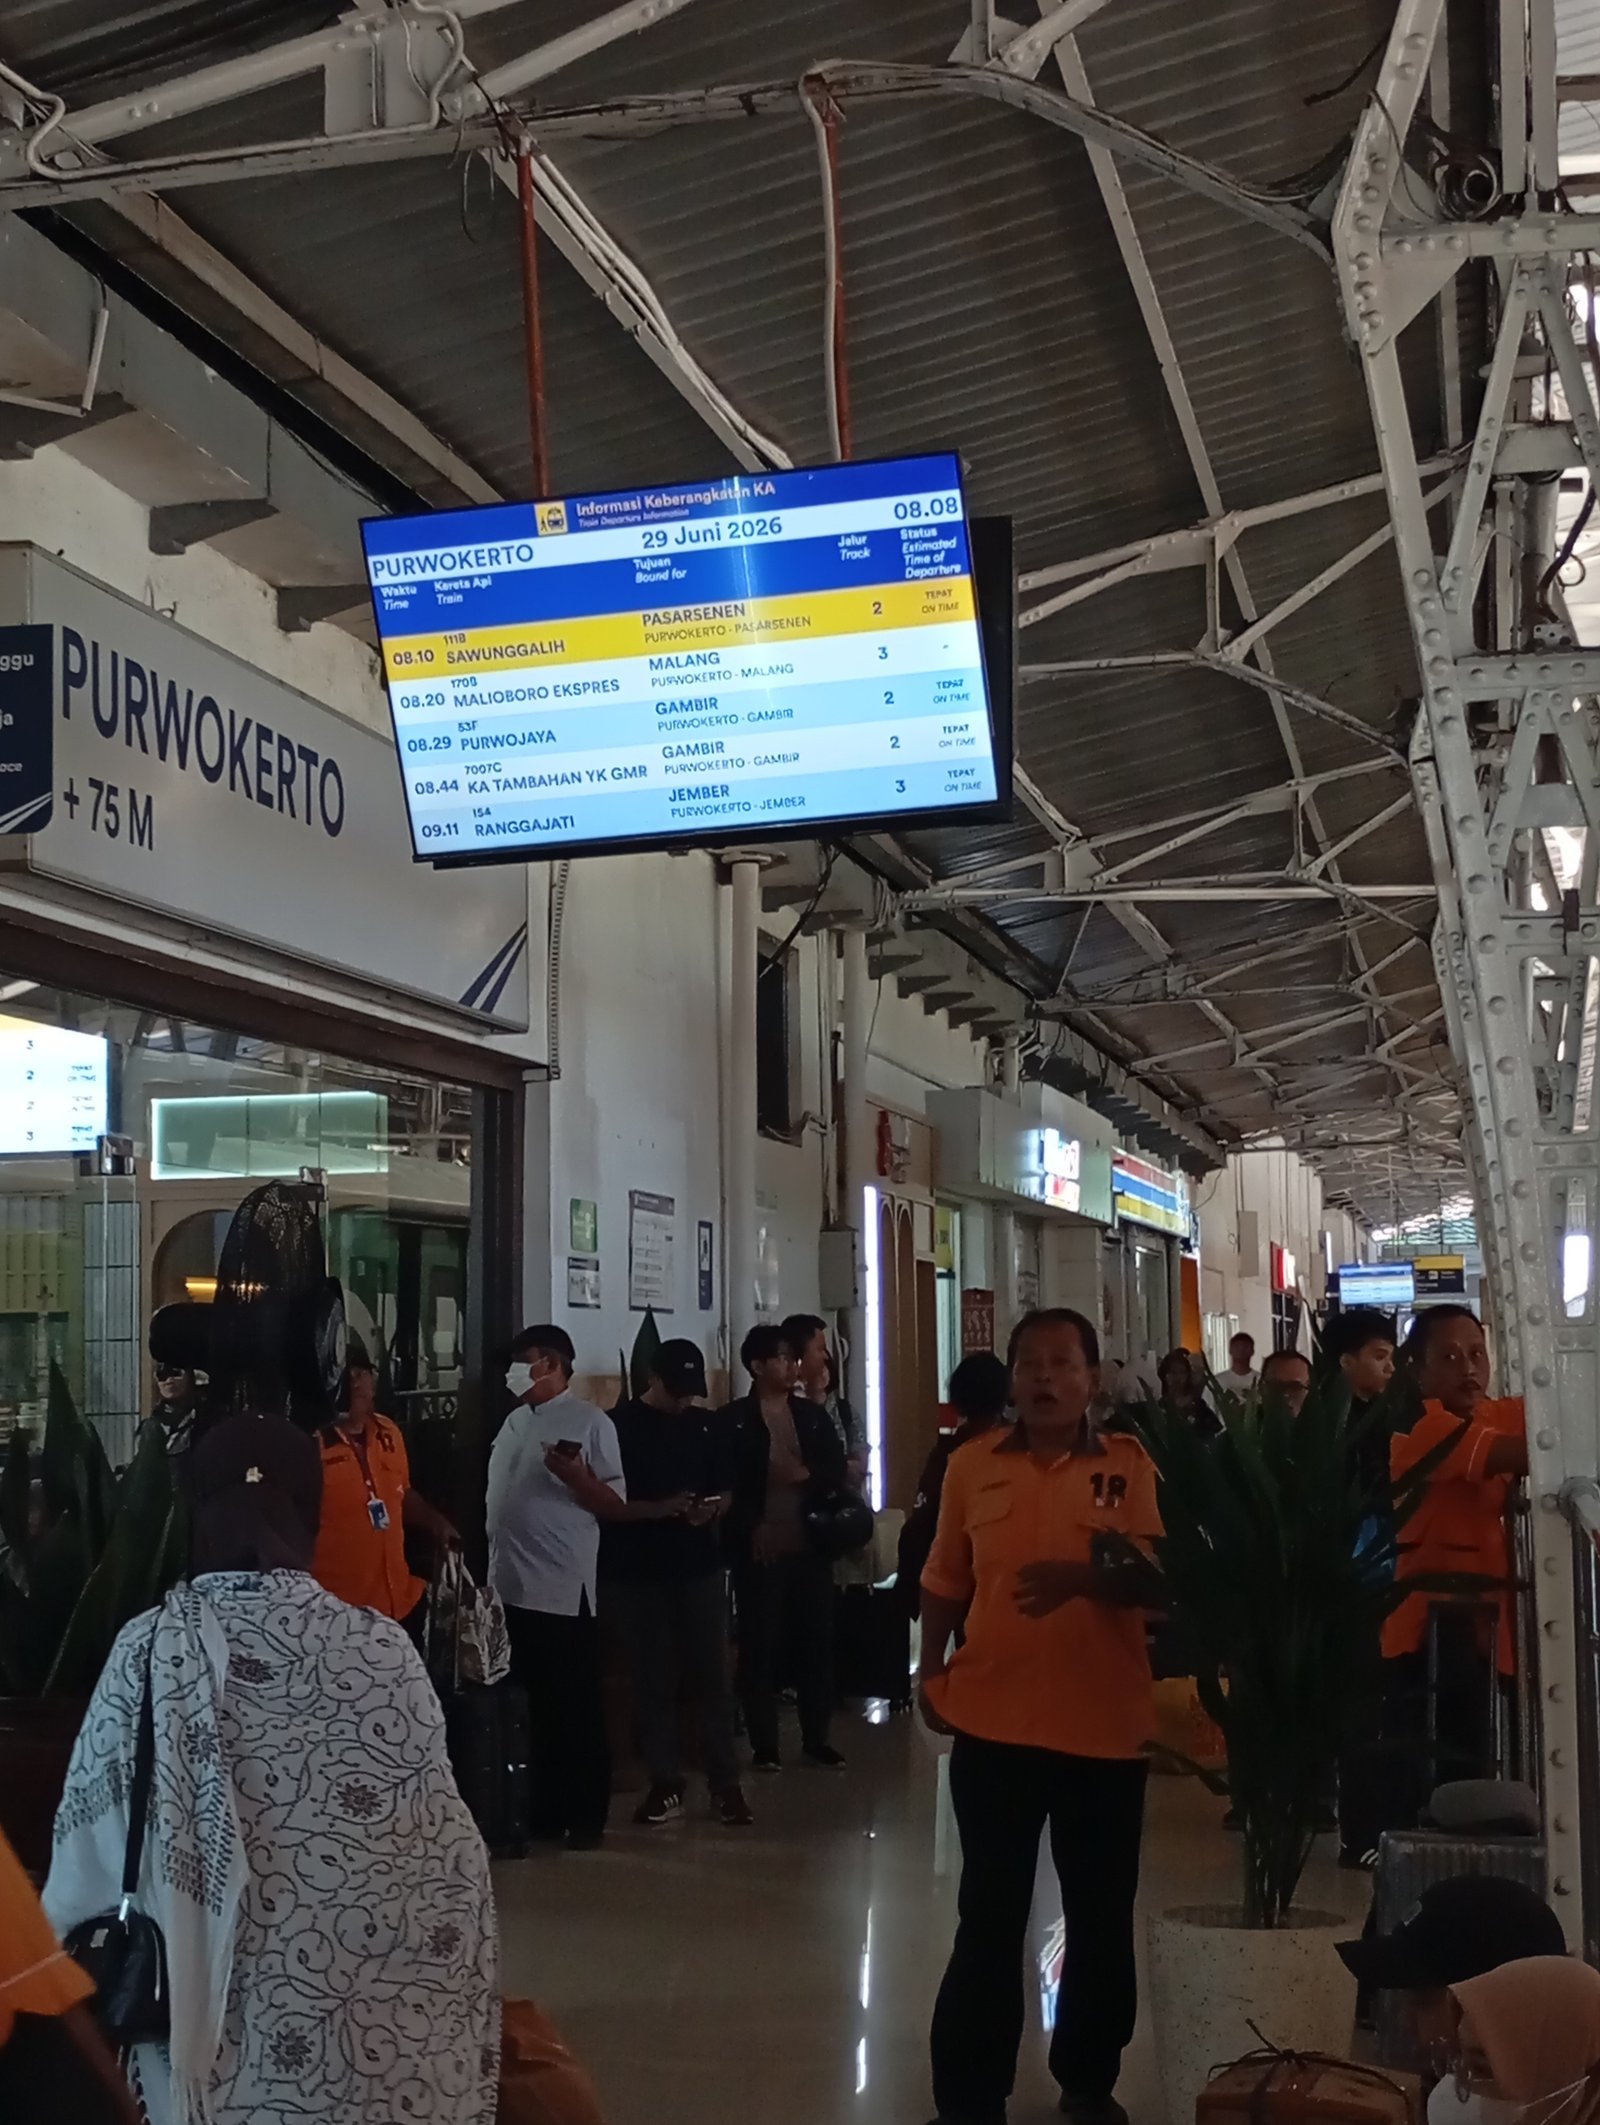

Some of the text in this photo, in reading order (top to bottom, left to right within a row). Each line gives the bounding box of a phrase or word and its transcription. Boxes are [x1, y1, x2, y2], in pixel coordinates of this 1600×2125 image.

[576, 480, 776, 516] Informasi Keberangkatan KA
[893, 497, 958, 520] 08.08
[641, 516, 782, 549] 29 Juni 2026
[900, 527, 938, 540] Status
[837, 535, 868, 548] Jalur
[902, 536, 957, 554] Estimated
[372, 544, 533, 579] PURWOKERTO
[840, 547, 871, 561] Track
[904, 550, 945, 566] Time of
[632, 557, 671, 571] Tujuan
[905, 563, 961, 579] Departure
[635, 567, 687, 583] Bound for
[381, 585, 417, 598] Waktu
[433, 575, 492, 592] Kereta Api
[436, 592, 463, 605] Train
[925, 589, 953, 600] TEPAT
[383, 599, 409, 610] Time
[872, 601, 883, 615] 2
[921, 602, 959, 614] ON TIME
[642, 603, 746, 627] PASARSENEN
[644, 625, 726, 643] PURWOKERTO
[735, 616, 812, 633] PASARSENEN
[393, 649, 435, 666] 08.10
[446, 640, 566, 664] SAWUNGGALIH
[878, 647, 888, 660] 3
[649, 652, 720, 671] MALANG
[651, 670, 732, 688] PURWOKERTO
[741, 663, 794, 679] MALANG
[399, 693, 446, 709] 08.20
[453, 679, 621, 708] MALIOBORO EKSPRES
[883, 691, 895, 705] 2
[933, 695, 947, 704] ON
[655, 697, 718, 715] GAMBIR
[657, 714, 738, 732] PURWOKERTO
[942, 724, 969, 734] TEPAT
[62, 625, 345, 838] PURWOKERTO
[407, 736, 452, 752] 08.29
[460, 729, 557, 751] PURWOJAYA
[890, 736, 901, 749] 2
[938, 740, 952, 748] ON
[662, 741, 725, 759] GAMBIR
[464, 762, 503, 776] 7007C
[664, 757, 745, 775] PURWOKERTO
[753, 752, 800, 767] GAMBIR
[467, 764, 648, 795] KA TAMBAHAN YK GMR
[947, 768, 975, 779] TEPAT
[414, 779, 460, 795] 08.44
[668, 784, 730, 802] JEMBER
[895, 780, 906, 793] 3
[944, 781, 982, 792] ON TIME
[472, 807, 492, 818] 154
[671, 801, 752, 818] PURWOKERTO
[759, 796, 806, 810] JEMBER
[421, 823, 460, 838] 09.11
[474, 815, 575, 837] RANGGAJATI
